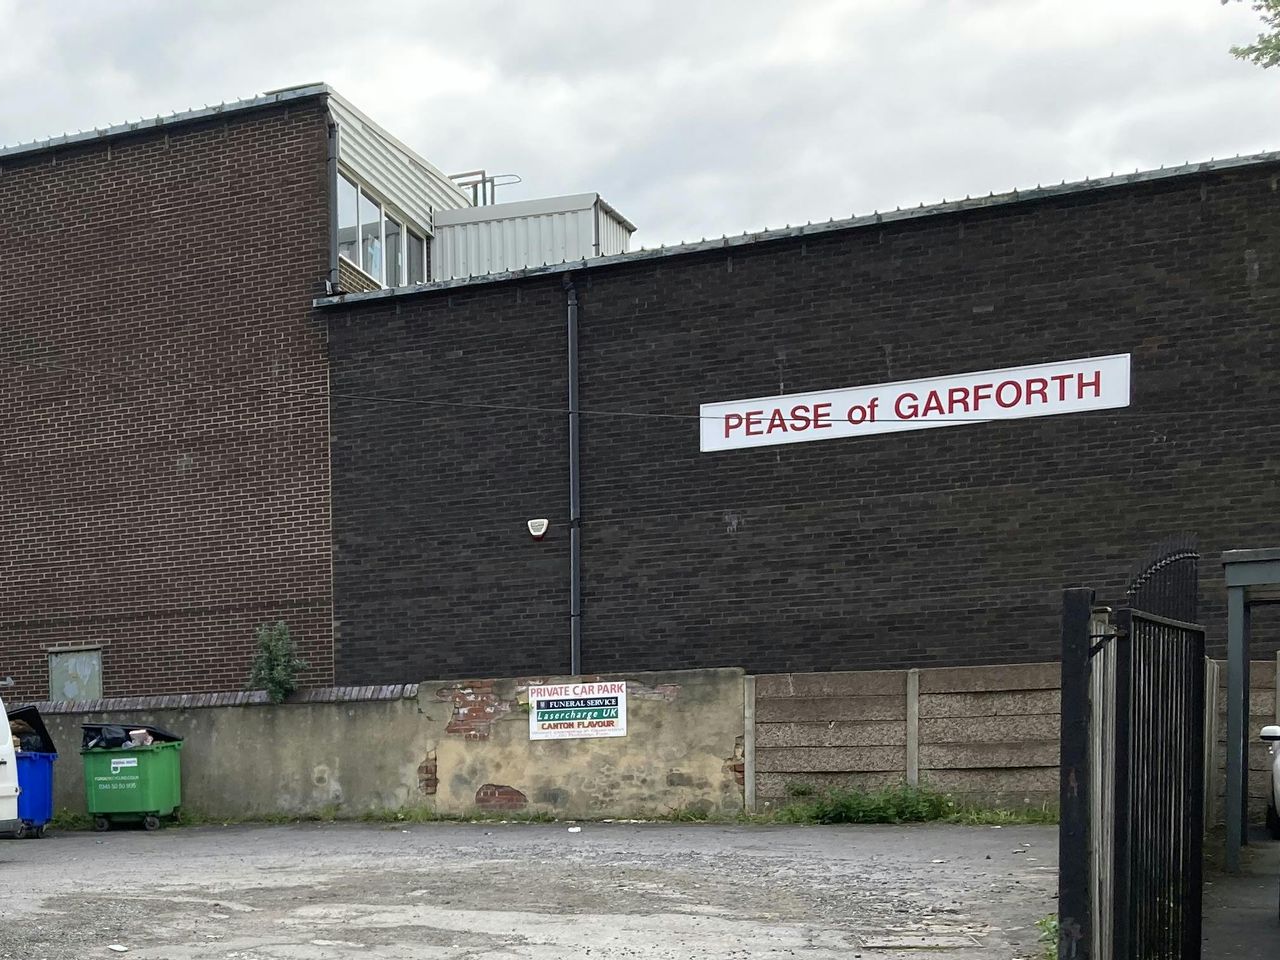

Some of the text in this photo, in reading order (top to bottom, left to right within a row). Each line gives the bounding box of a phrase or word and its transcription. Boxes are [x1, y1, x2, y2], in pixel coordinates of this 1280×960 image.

[724, 370, 1101, 438] PEASE of GARFORTH
[530, 683, 624, 698] PRIVATE CAR PARK
[549, 698, 617, 708] FUNERAL SERVICE
[537, 708, 617, 720] Lasercharge UK
[541, 720, 615, 730] CANTON FLAVOUR
